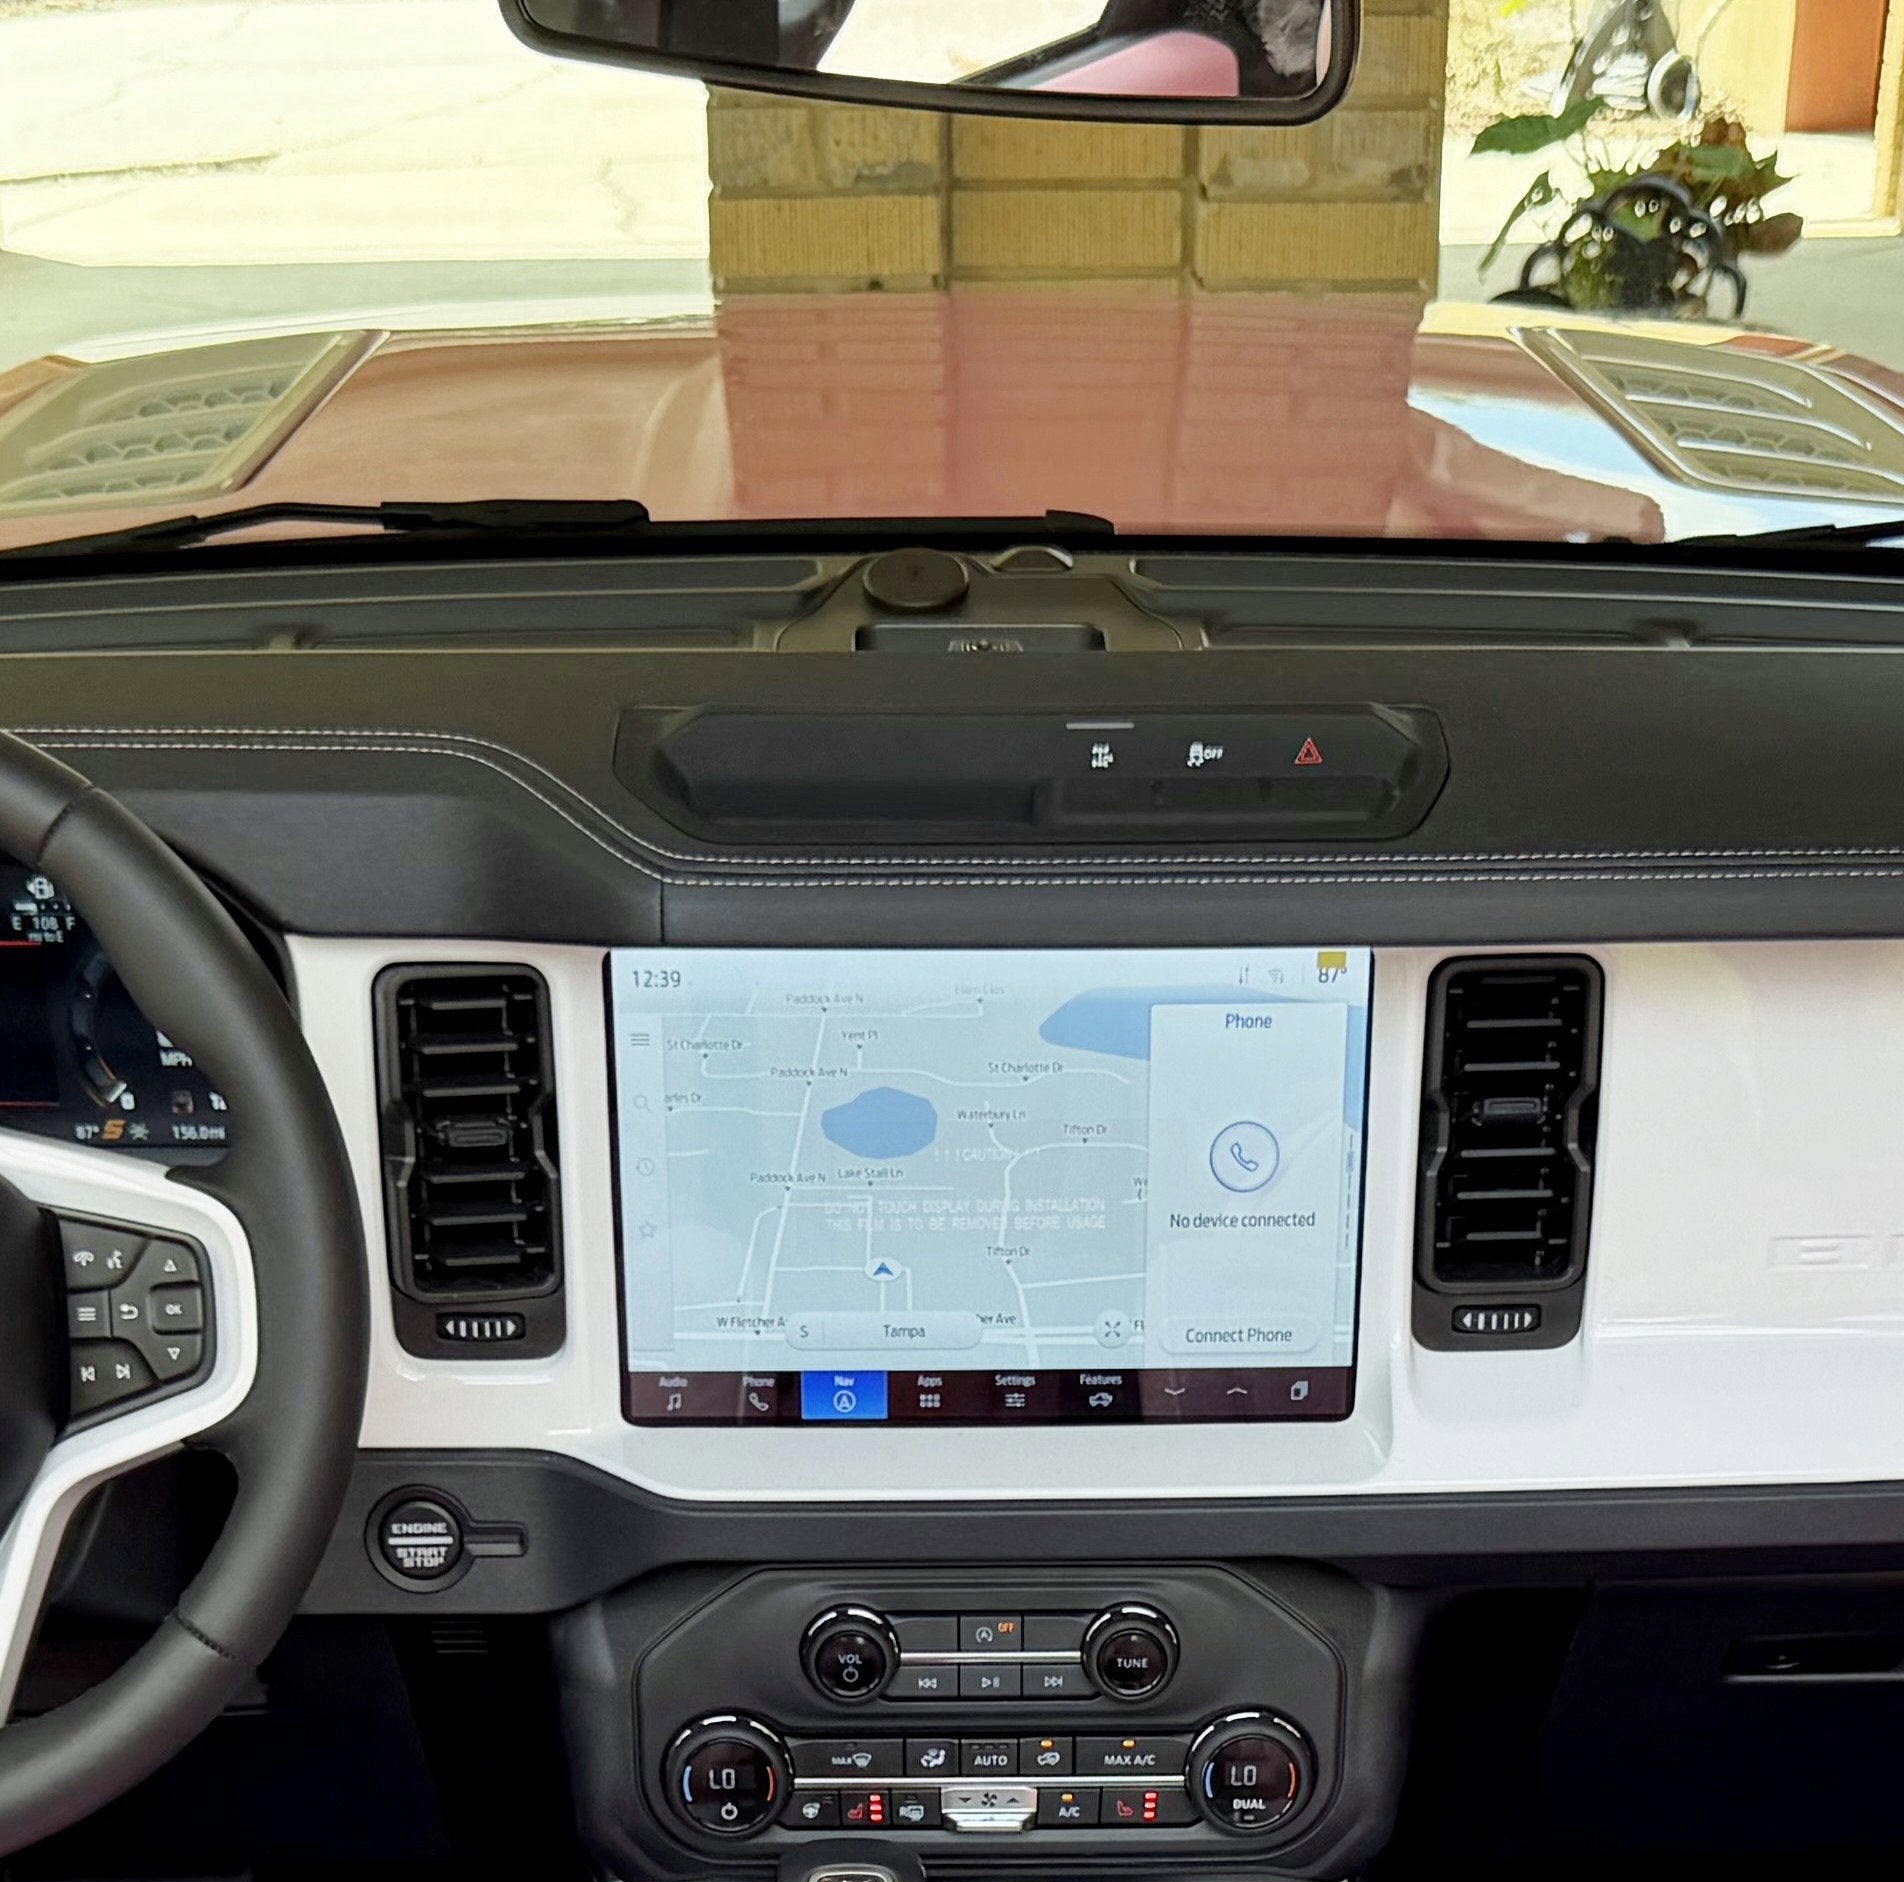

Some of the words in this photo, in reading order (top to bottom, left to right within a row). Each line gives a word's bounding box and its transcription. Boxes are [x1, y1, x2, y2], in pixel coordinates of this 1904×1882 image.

[11, 914, 22, 931] E
[65, 916, 75, 930] F
[632, 970, 682, 988] 12:39
[786, 993, 831, 1004] Paddock
[1225, 1013, 1273, 1030] Phone
[667, 1040, 678, 1050] St
[680, 1039, 730, 1050] Charlotte
[732, 1039, 743, 1050] Dr
[771, 1067, 816, 1078] Paddock
[818, 1067, 836, 1078] Ave
[988, 1062, 999, 1073] St
[1001, 1062, 1050, 1073] Charlotte
[1053, 1062, 1064, 1072] Dr
[691, 1092, 702, 1103] Dr
[957, 1109, 1011, 1121] Waterbury
[1013, 1109, 1026, 1119] Ln
[1064, 1124, 1095, 1136] Tifton
[1097, 1124, 1107, 1135] Dr
[750, 1172, 795, 1183] Paddock
[797, 1172, 816, 1183] Ave
[837, 1168, 862, 1179] Lake
[891, 1168, 903, 1178] Ln
[923, 1200, 972, 1213] DISPLAY
[1025, 1198, 1106, 1213] INSTALLATION
[930, 1217, 946, 1231] BE
[1014, 1216, 1060, 1230] BEFORE
[1066, 1215, 1106, 1230] USAGE
[1169, 1213, 1190, 1229] No
[1192, 1212, 1239, 1229] device
[1241, 1211, 1316, 1228] connected
[1020, 1246, 1030, 1256] Dr
[165, 1303, 183, 1315] OK
[716, 1316, 728, 1327] W
[730, 1316, 775, 1328] Fletcher
[996, 1313, 1017, 1324] Ave
[800, 1325, 809, 1338] S
[883, 1325, 926, 1339] Tampa
[1186, 1328, 1244, 1343] Connect
[1247, 1327, 1292, 1343] Phone
[742, 1376, 775, 1388] Phone
[833, 1376, 855, 1387] Nav
[917, 1375, 943, 1387] Apps
[995, 1374, 1036, 1388] Settings
[1079, 1373, 1123, 1386] Features
[391, 1522, 449, 1535] ENGINE
[395, 1546, 449, 1558] START
[402, 1557, 445, 1568] STOP
[997, 1622, 1017, 1635] OFF
[837, 1653, 863, 1666] VOL
[1116, 1657, 1150, 1669] TUNE
[973, 1754, 1009, 1767] AUTO
[1104, 1754, 1131, 1766] MAX
[1133, 1754, 1157, 1766] A/C
[707, 1768, 737, 1790] LO
[1229, 1764, 1258, 1787] LO
[1232, 1798, 1267, 1810] DUAL
[1058, 1806, 1081, 1819] A/C
